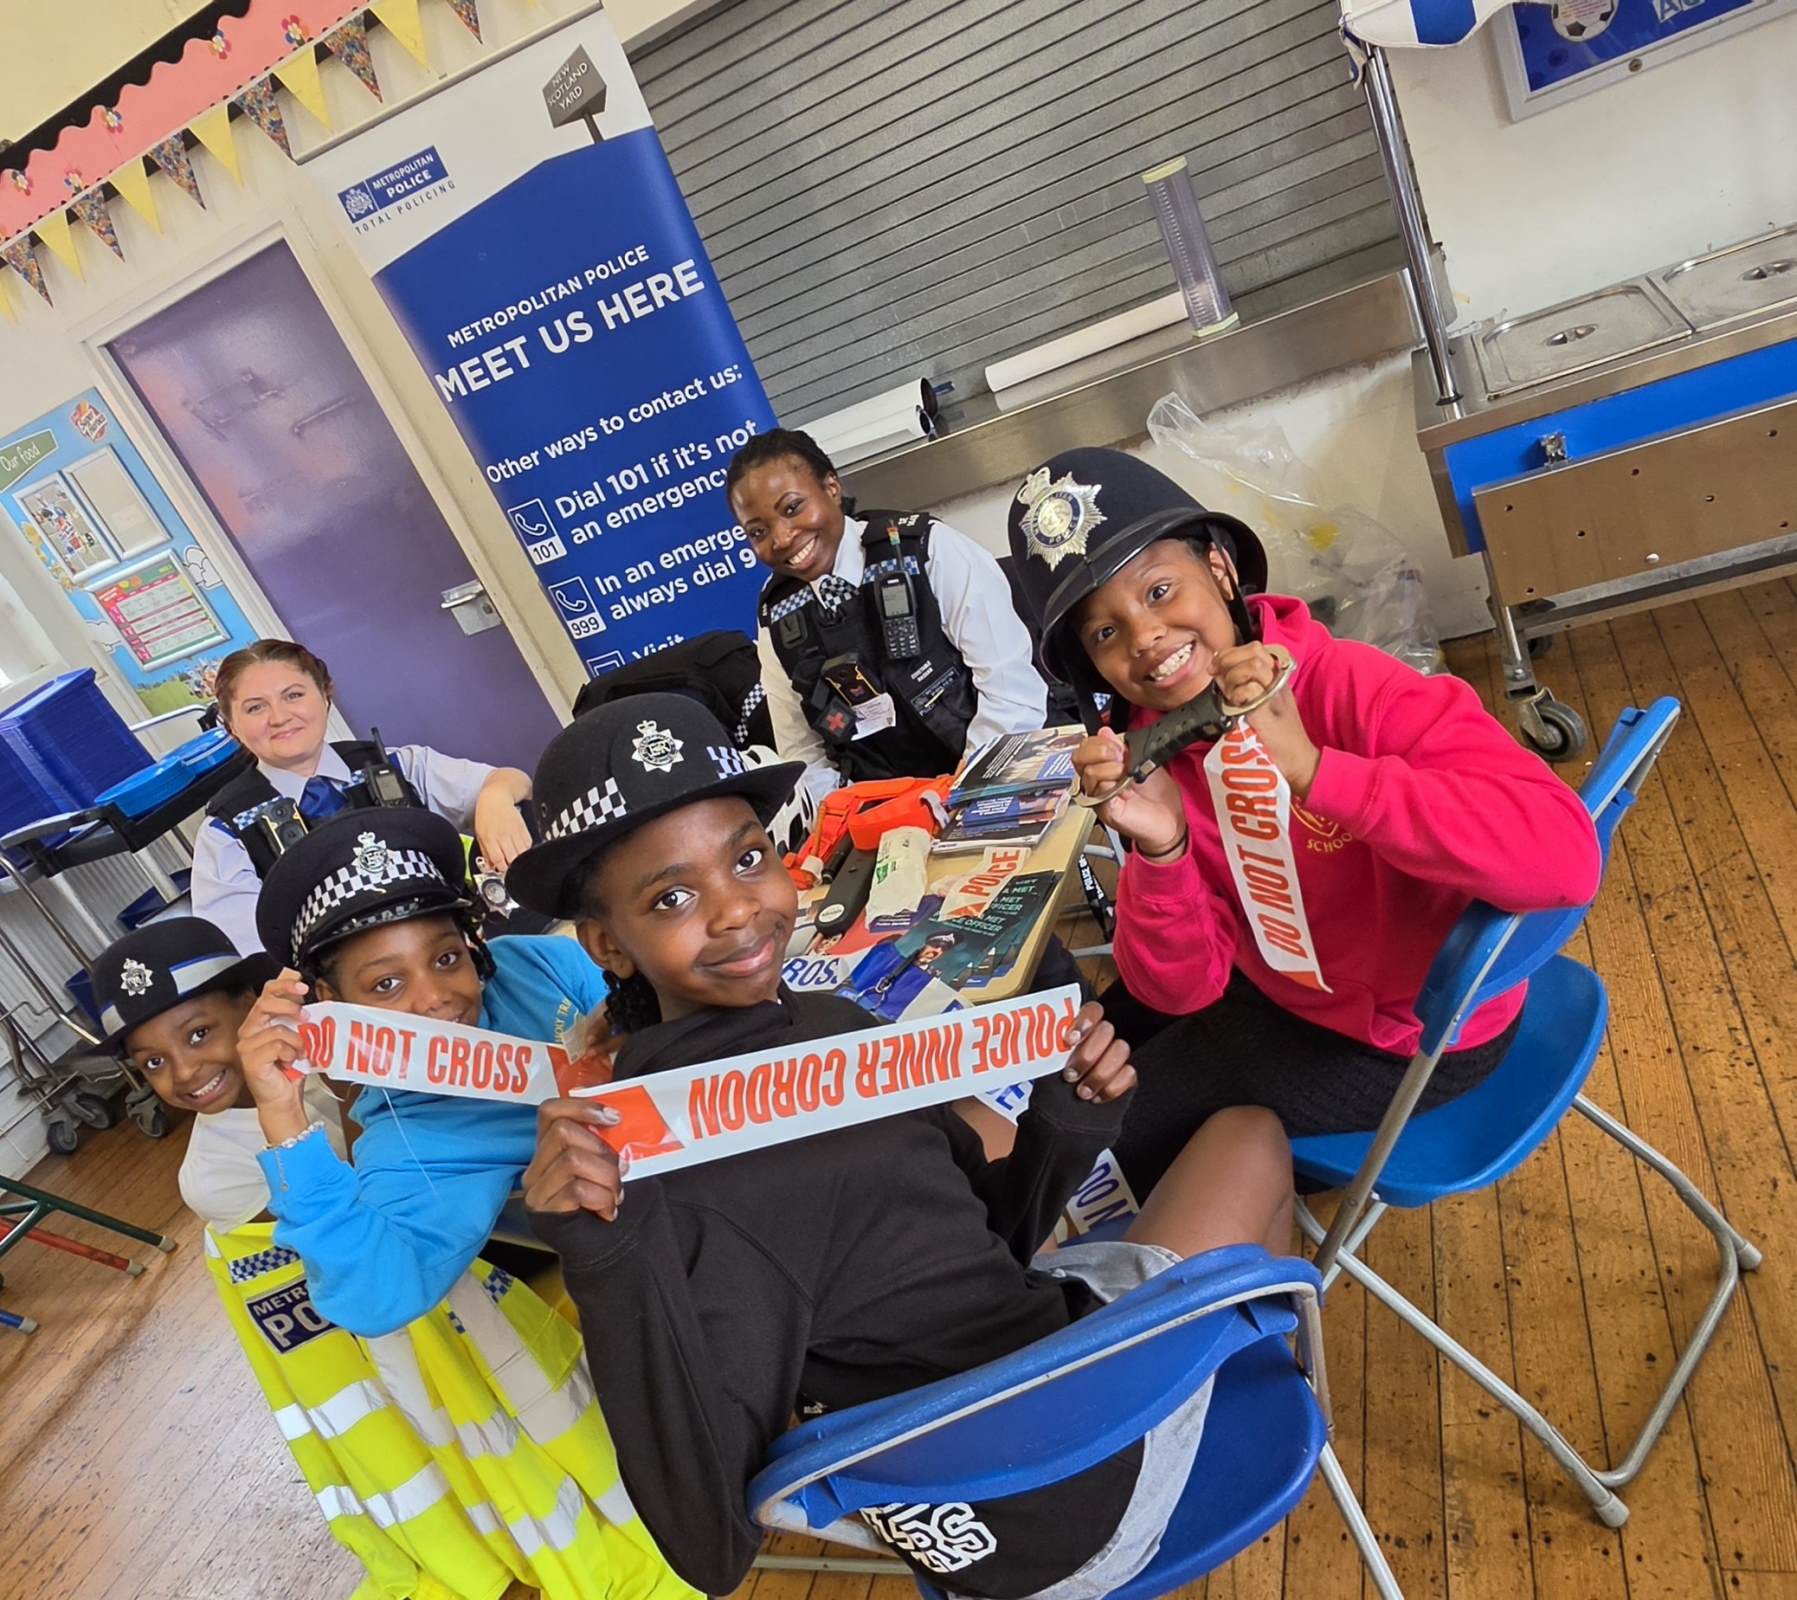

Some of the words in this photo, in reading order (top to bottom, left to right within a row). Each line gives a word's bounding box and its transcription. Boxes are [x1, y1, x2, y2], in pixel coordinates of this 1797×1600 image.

[548, 62, 588, 107] SCOTLAND
[559, 86, 583, 110] YARD
[372, 152, 434, 190] METROPOLITAN
[386, 169, 432, 199] POLICE
[355, 212, 392, 235] TOTAL
[396, 180, 456, 215] POLICING
[434, 336, 530, 403] MEET
[538, 310, 594, 355] US
[597, 258, 706, 331] HERE
[447, 275, 583, 349] METROPOLITAN
[586, 244, 650, 287] POLICE
[20, 443, 41, 471] food
[486, 449, 541, 484] Other
[543, 426, 599, 460] ways
[599, 414, 625, 436] to
[628, 376, 708, 424] contact
[709, 363, 744, 391] us:
[554, 482, 607, 519] Dial
[606, 463, 650, 497] 101
[650, 452, 671, 479] if
[672, 442, 712, 471] it's
[715, 419, 758, 453] not
[570, 521, 602, 546] an
[606, 467, 728, 529] emergenc
[532, 540, 560, 563] 101
[594, 573, 622, 597] In
[624, 559, 656, 584] an
[659, 523, 748, 572] emerge
[610, 575, 689, 622] always
[692, 554, 738, 587] dial
[571, 616, 601, 636] 999
[1306, 832, 1353, 853] SCHOO
[1237, 844, 1297, 915] NOT
[1256, 912, 1309, 960] DO
[780, 957, 840, 986] ROS
[297, 1015, 337, 1068] DO
[345, 1020, 417, 1080] NOT
[427, 1035, 532, 1094] CROSS
[855, 1022, 964, 1099] INNER
[971, 997, 1075, 1075] POLICE
[687, 1047, 847, 1140] CORDON
